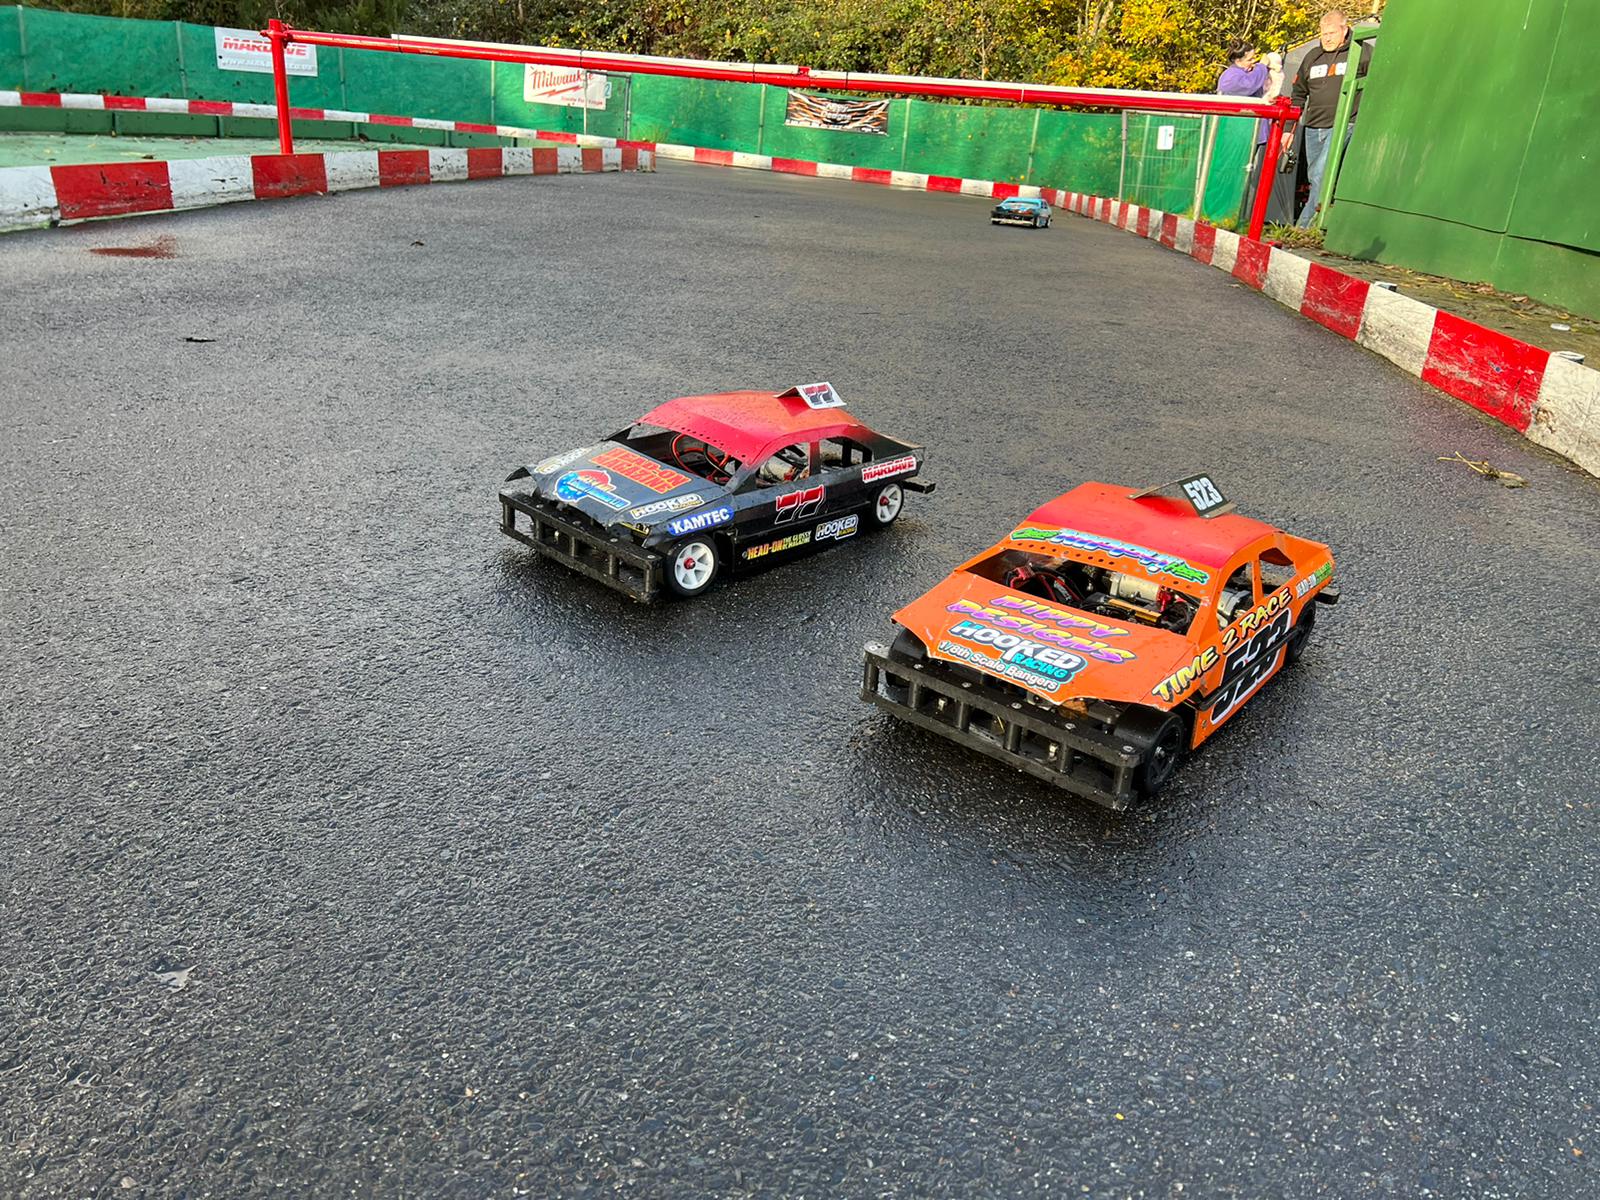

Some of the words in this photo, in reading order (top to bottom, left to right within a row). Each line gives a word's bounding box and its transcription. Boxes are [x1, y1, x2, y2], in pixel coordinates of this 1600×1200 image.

[223, 37, 307, 56] MARDVE
[531, 69, 593, 89] Milwauke
[804, 384, 835, 405] 77
[863, 456, 915, 481] MARDAVE
[631, 494, 700, 519] HOOKED
[774, 484, 825, 525] 77
[1182, 477, 1223, 511] 523
[671, 509, 731, 534] KAMTEC
[816, 516, 857, 538] HOOKED
[747, 538, 784, 560] HEAD-ON
[990, 595, 1130, 637] NIPPY
[946, 599, 1137, 664] DESIGNS
[1152, 646, 1220, 701] TIME
[1222, 628, 1239, 653] 2
[1239, 587, 1292, 638] RACE
[951, 621, 1083, 670] HOOKED
[971, 652, 1006, 673] Scale
[1005, 665, 1058, 691] Bangers
[1012, 652, 1069, 679] RACING
